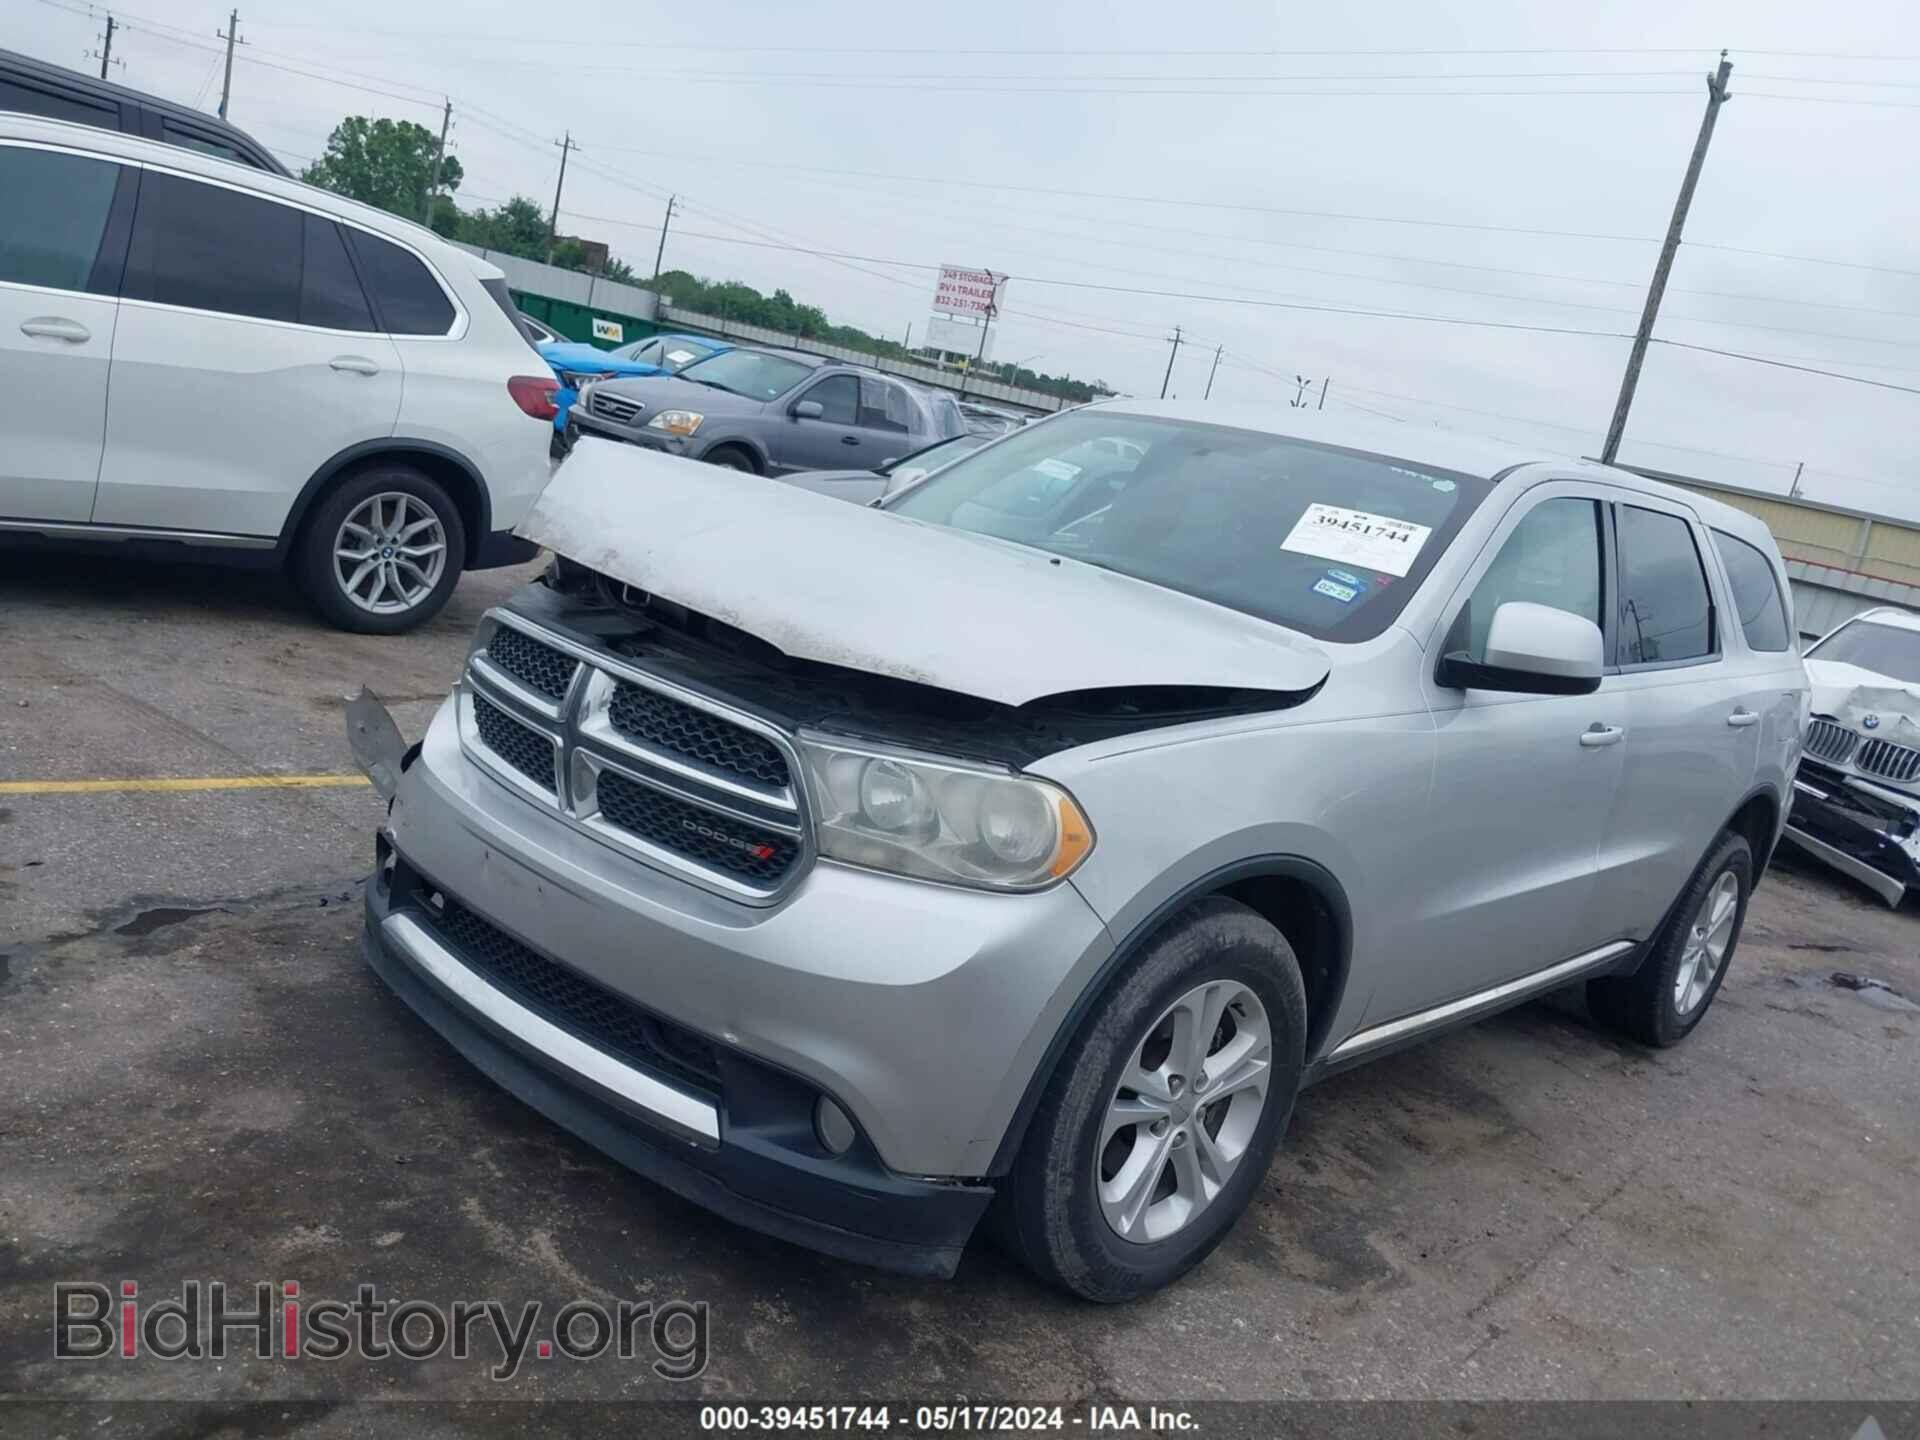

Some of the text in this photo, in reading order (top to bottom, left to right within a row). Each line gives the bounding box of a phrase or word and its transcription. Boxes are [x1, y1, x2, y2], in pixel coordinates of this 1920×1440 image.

[957, 285, 992, 299] TRAILER
[935, 295, 990, 312] 832-251-730
[596, 324, 619, 337] WM
[1312, 515, 1409, 543] 39451744
[682, 820, 756, 853] DODGE
